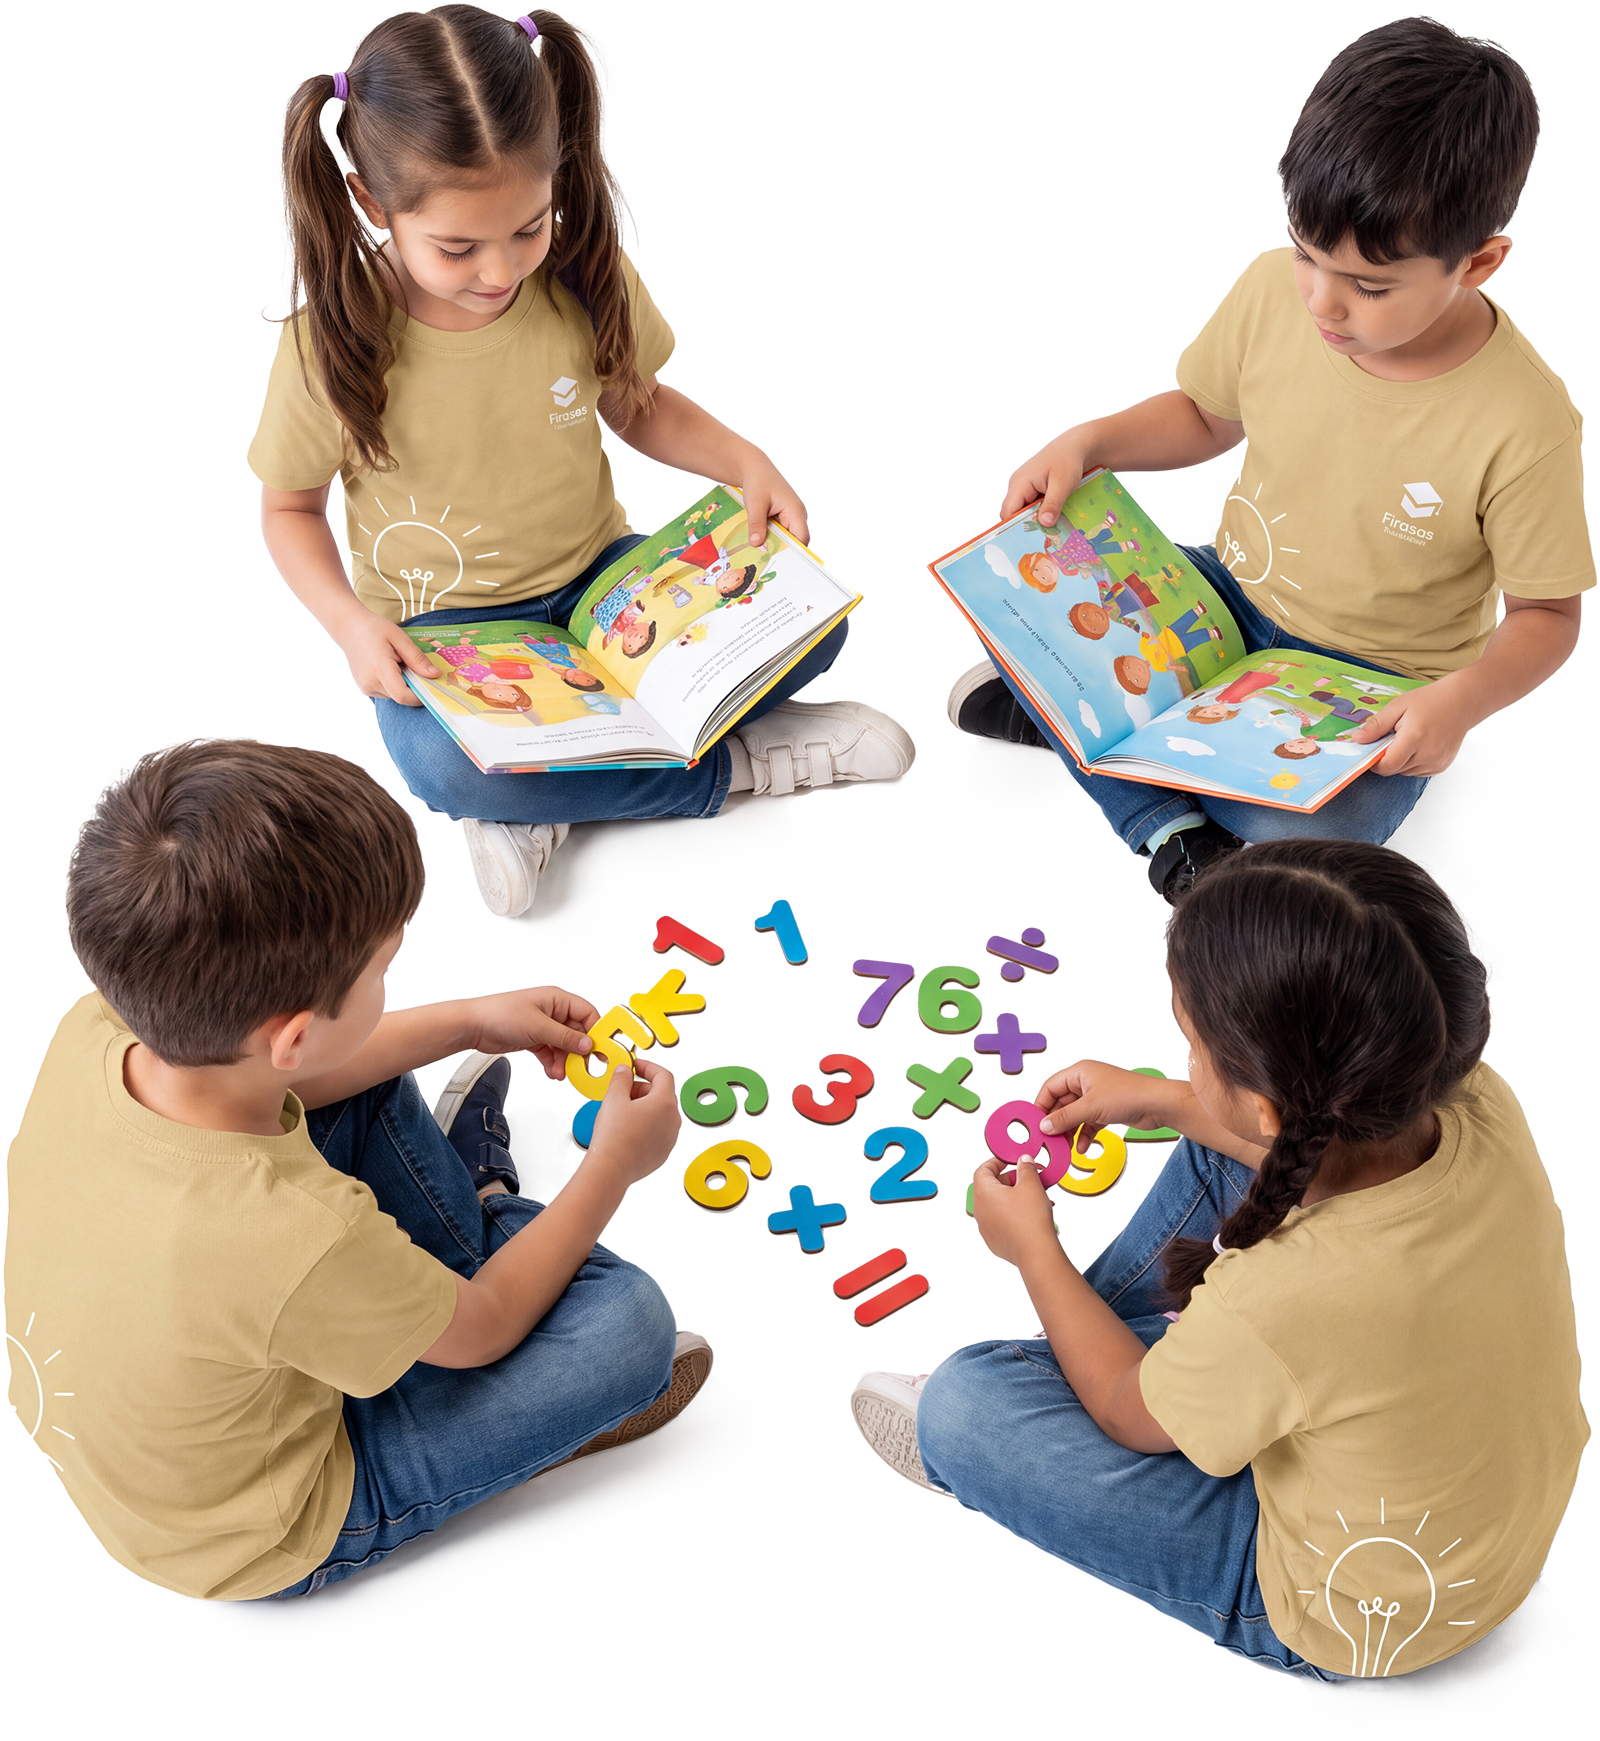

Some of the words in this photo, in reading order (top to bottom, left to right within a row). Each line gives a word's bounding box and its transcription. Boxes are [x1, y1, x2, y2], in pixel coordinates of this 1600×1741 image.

[1382, 511, 1434, 540] Firasas
[755, 900, 808, 965] 1
[853, 959, 914, 1028] 7
[918, 966, 982, 1034] 6
[793, 1054, 874, 1125] 3
[864, 1126, 938, 1204] 2
